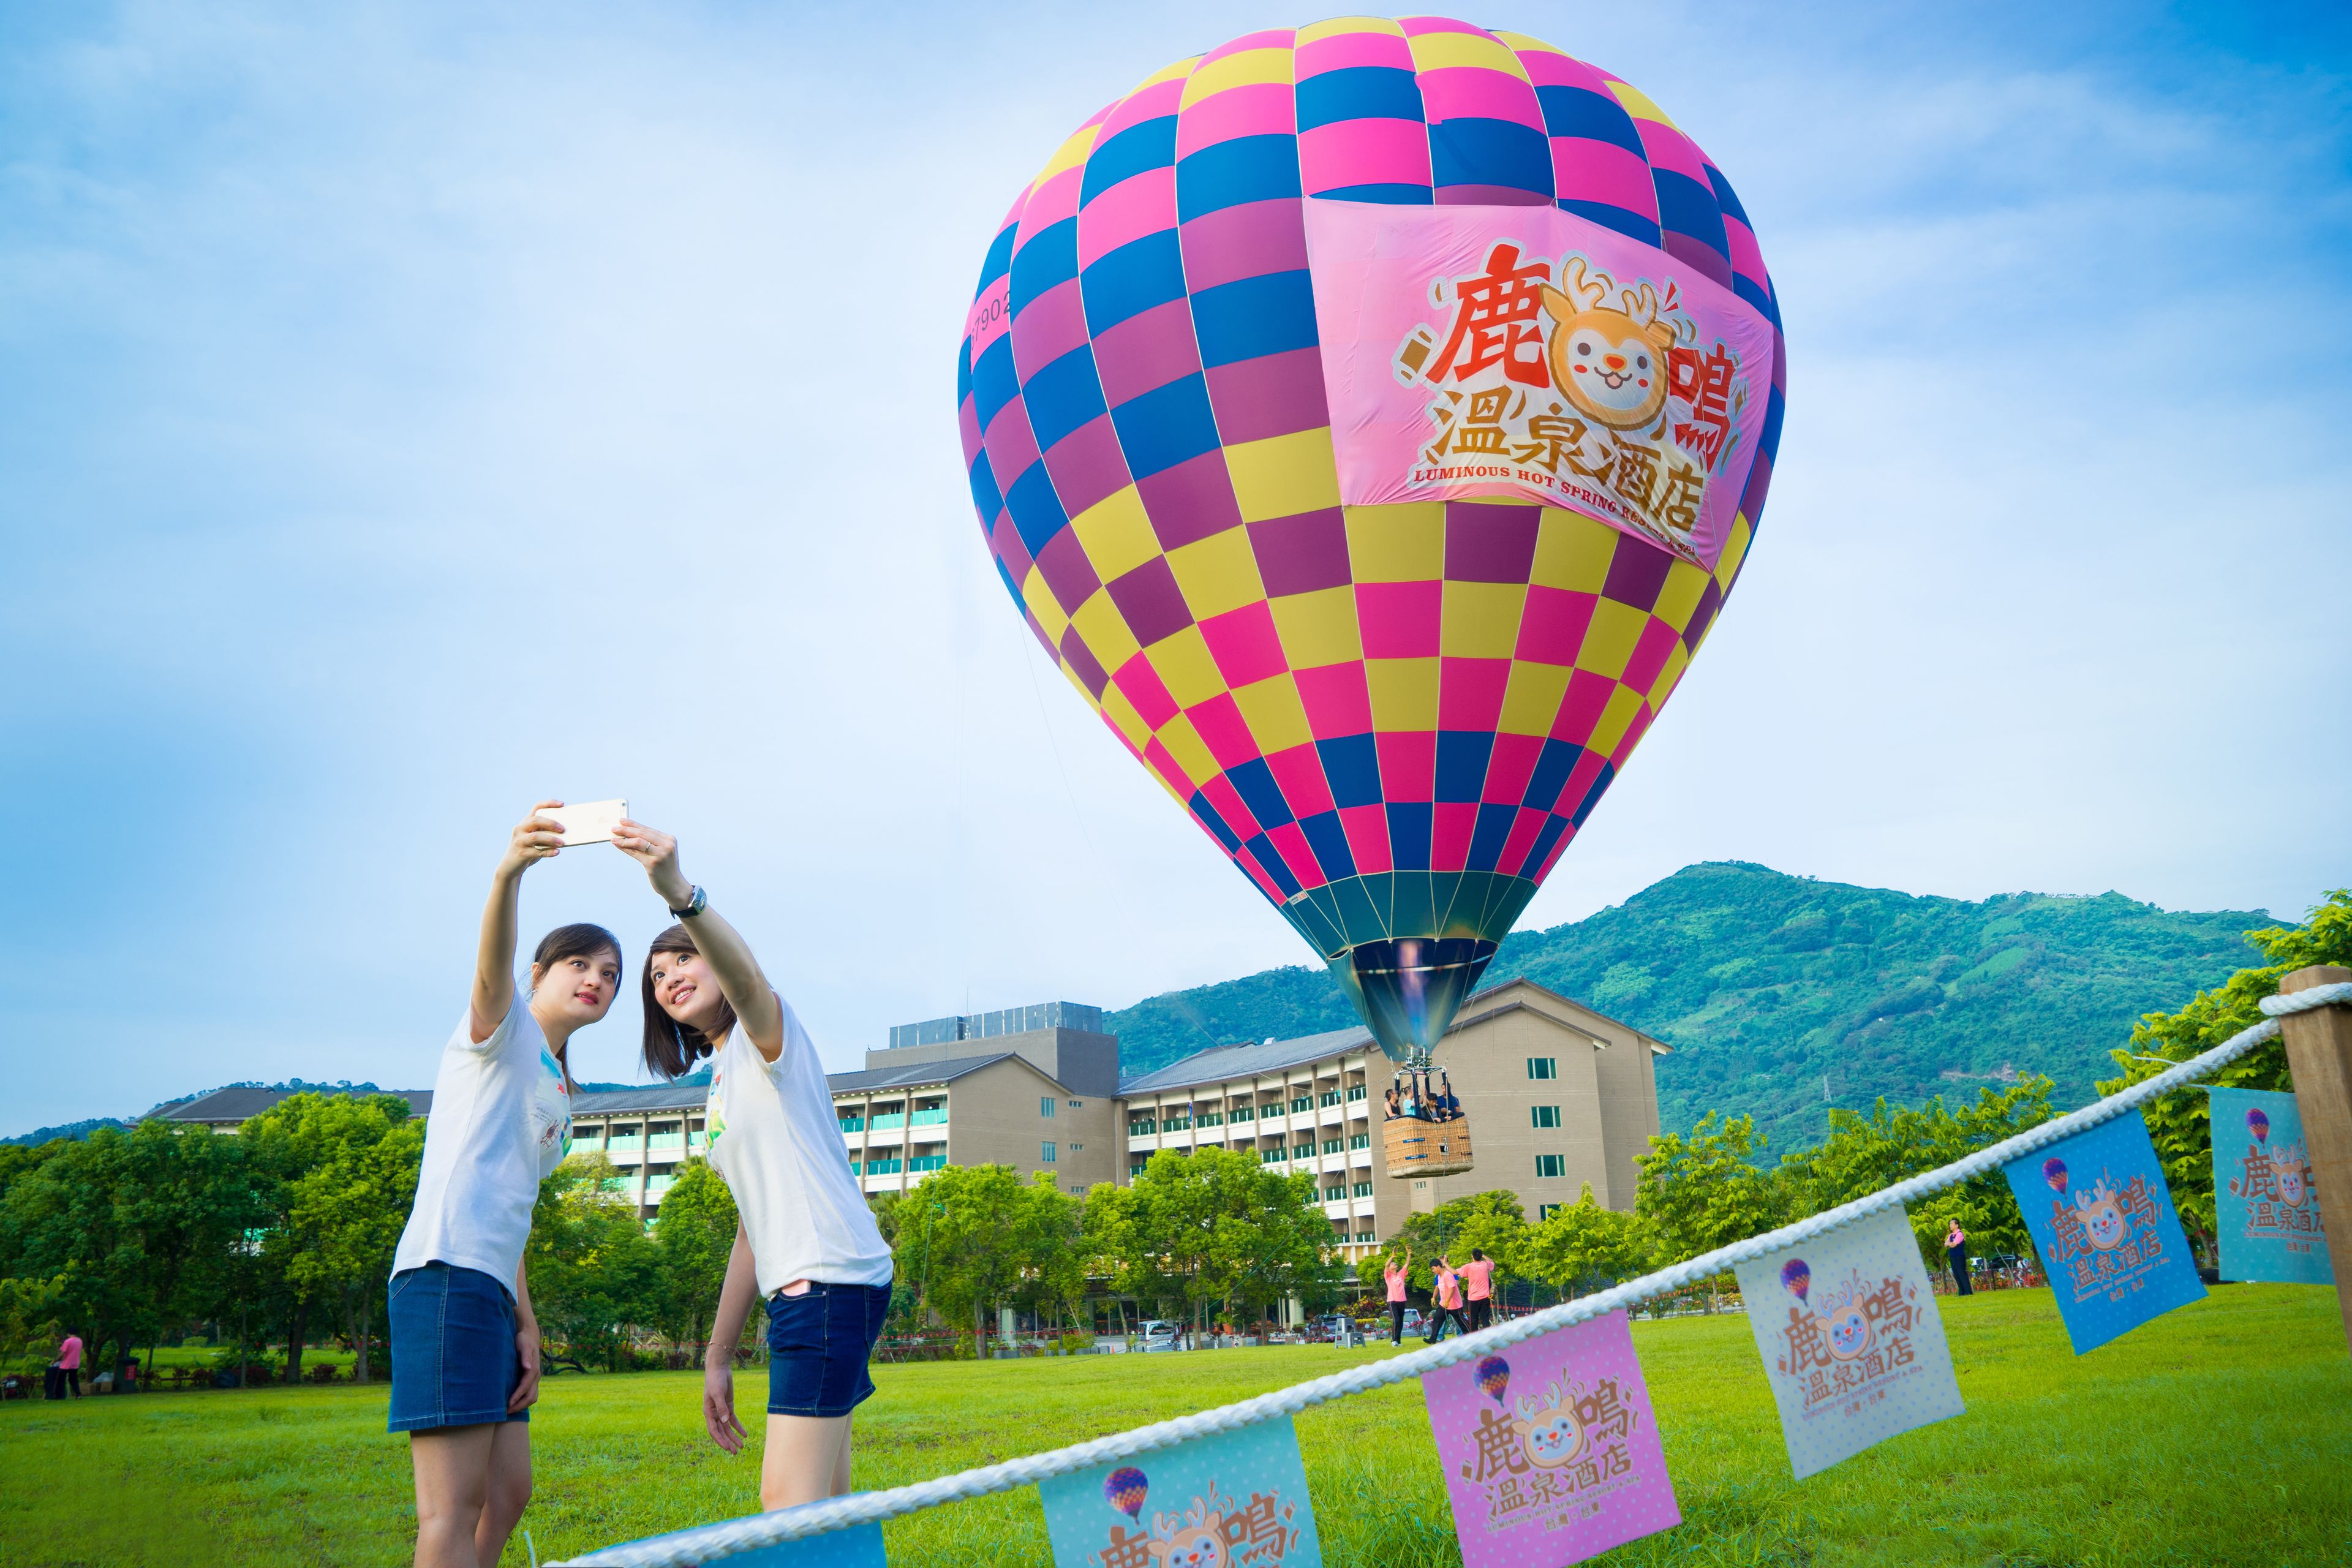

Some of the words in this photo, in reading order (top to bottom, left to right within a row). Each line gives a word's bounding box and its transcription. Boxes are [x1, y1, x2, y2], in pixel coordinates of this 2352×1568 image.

[1425, 244, 1550, 388] 鹿
[1668, 342, 1736, 474] 鳴
[1431, 384, 1704, 532] 溫泉酒店
[1414, 466, 1510, 482] LUMINOUS
[1517, 469, 1555, 488] HOT
[1561, 481, 1618, 513] SPRING
[1678, 543, 1695, 556] SPA
[2239, 1144, 2280, 1202] 鹿
[2051, 1200, 2095, 1262] 鹿
[2115, 1175, 2157, 1230] 鳴
[2067, 1230, 2162, 1291] 溫泉酒店
[1784, 1306, 1832, 1375] 鹿
[1863, 1278, 1912, 1338] 鳴
[1798, 1336, 1915, 1407] 溫泉酒店
[1472, 1409, 1530, 1483] 鹿
[1575, 1379, 1629, 1444] 鳴
[1485, 1444, 1632, 1517] 溫泉酒店
[1223, 1493, 1287, 1564] 鳴
